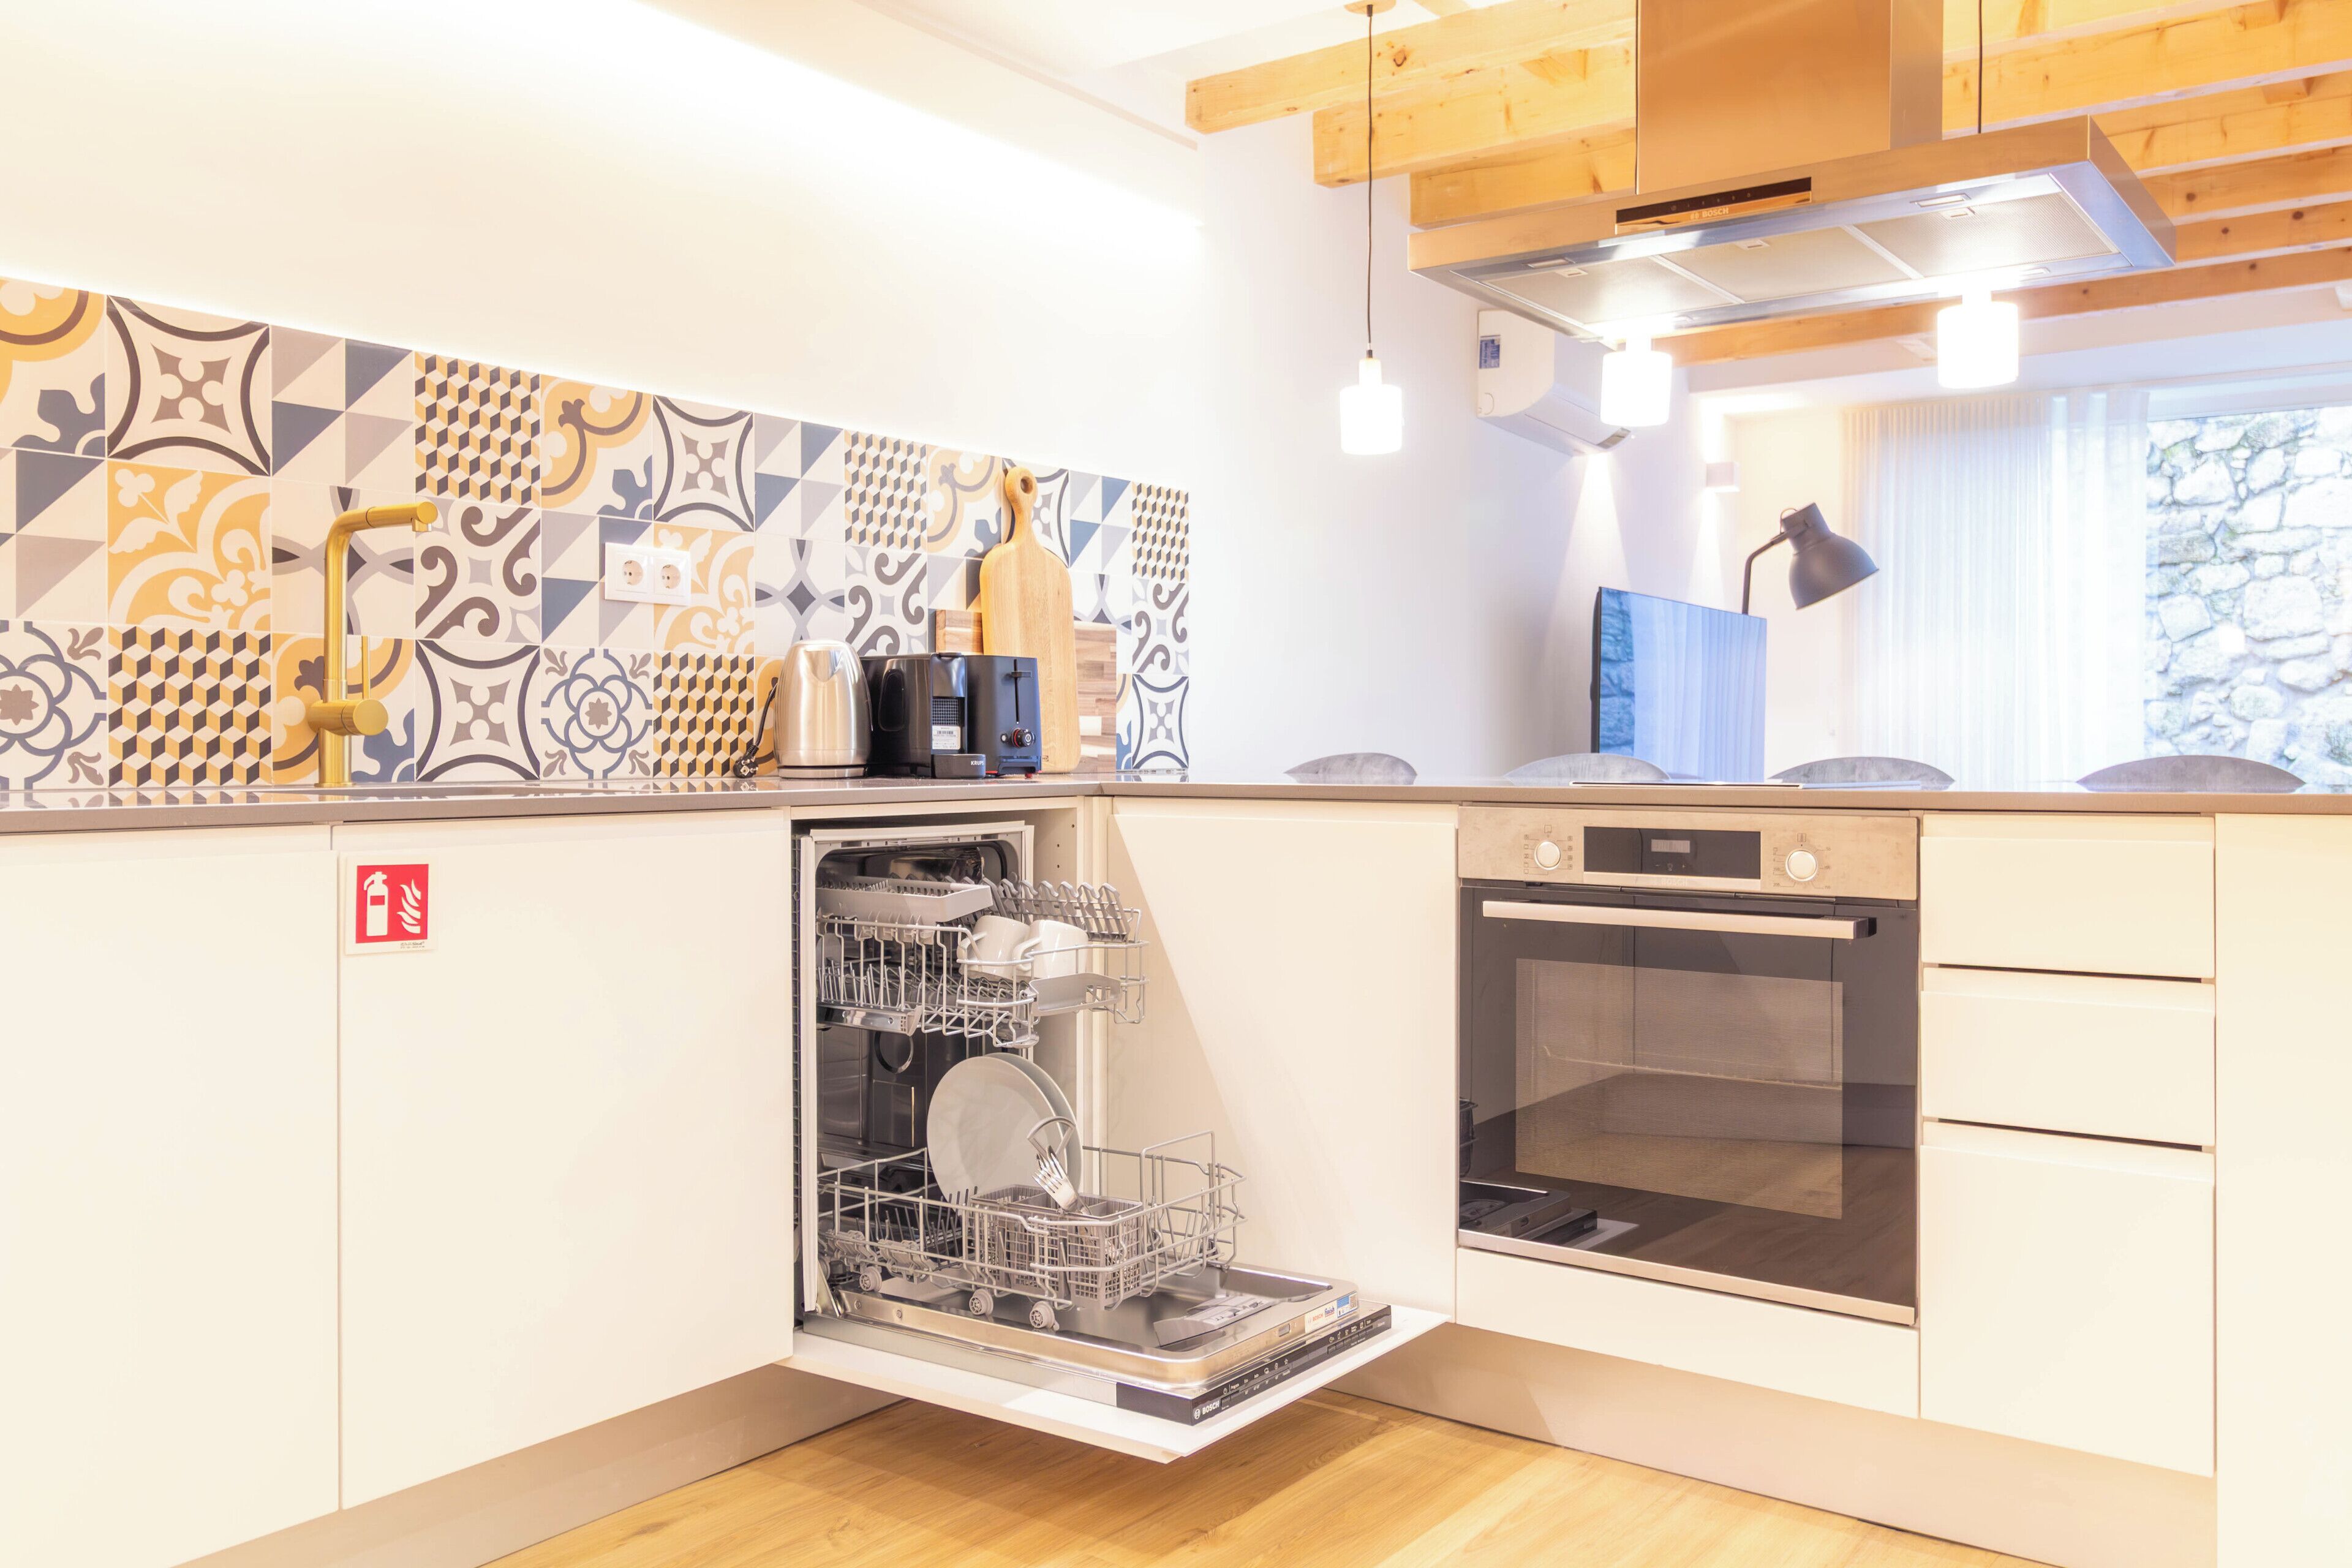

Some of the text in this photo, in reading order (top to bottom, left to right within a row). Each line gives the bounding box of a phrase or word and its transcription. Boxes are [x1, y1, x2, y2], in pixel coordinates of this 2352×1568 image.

[1702, 207, 1729, 217] BOSCH
[1661, 877, 1688, 887] BOSCH
[1202, 1400, 1219, 1415] BOSCH
